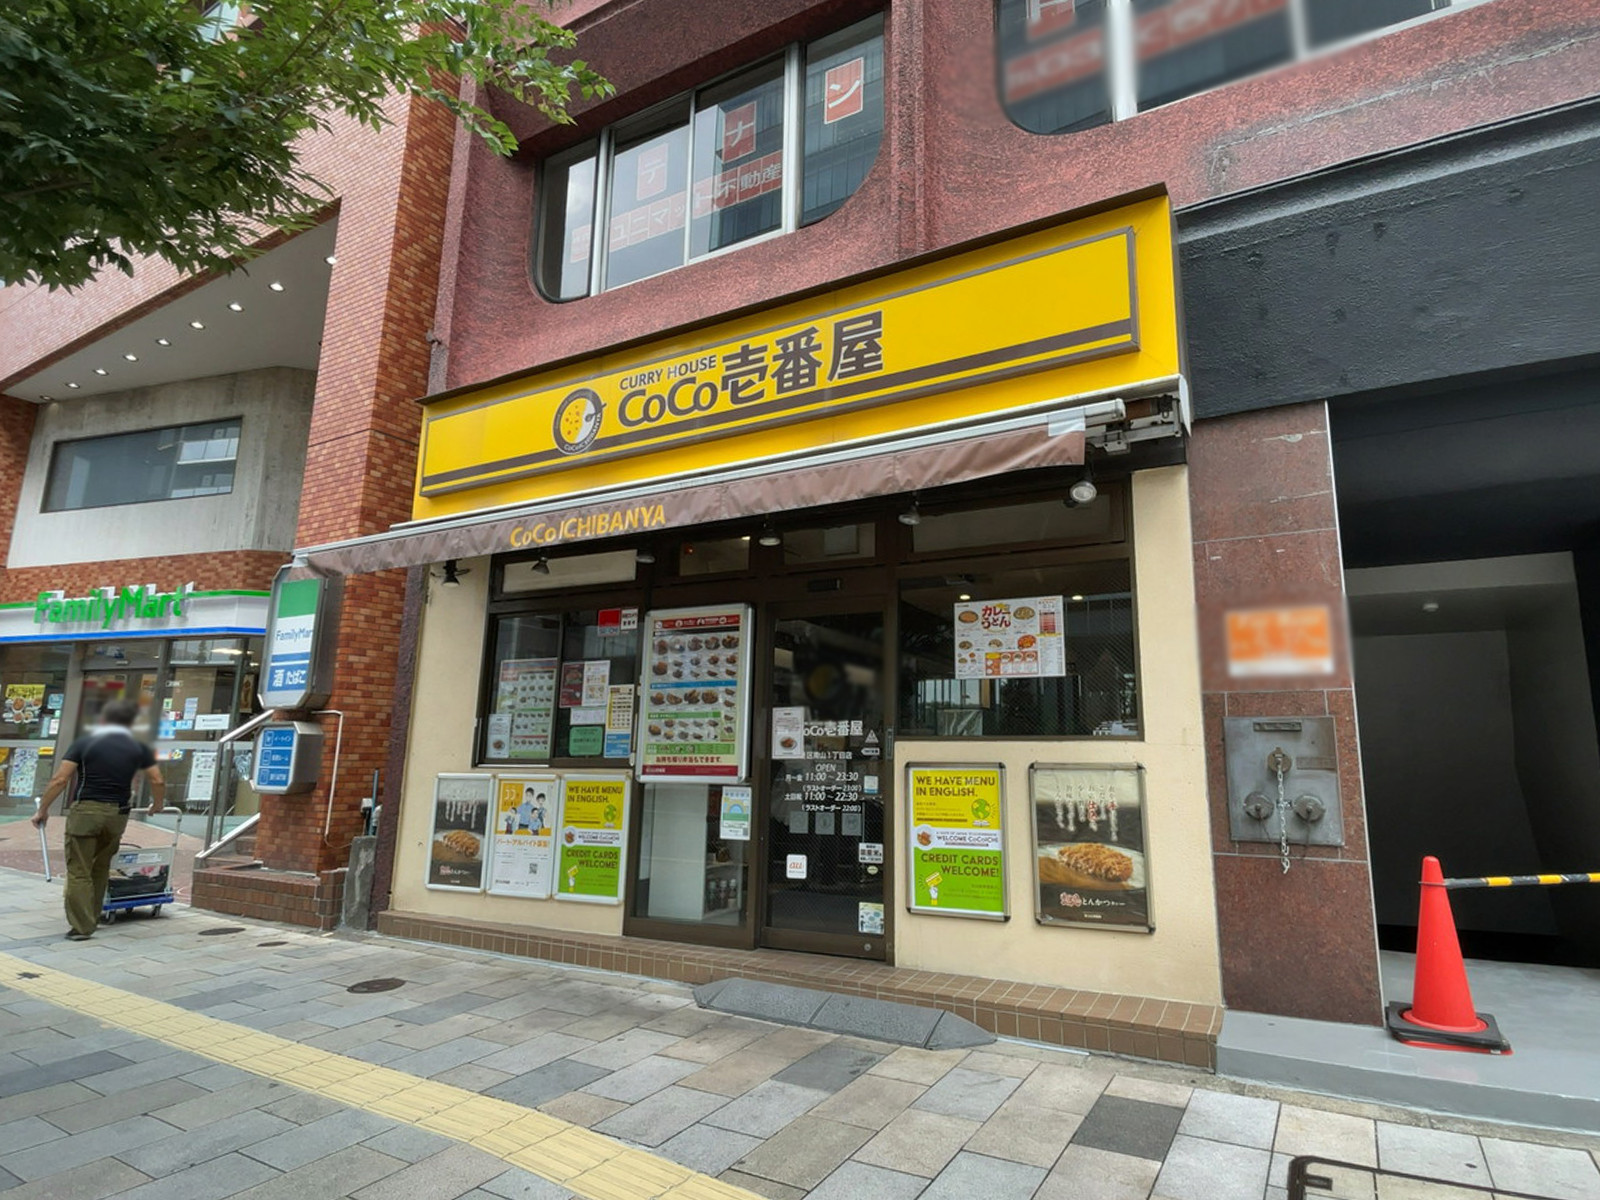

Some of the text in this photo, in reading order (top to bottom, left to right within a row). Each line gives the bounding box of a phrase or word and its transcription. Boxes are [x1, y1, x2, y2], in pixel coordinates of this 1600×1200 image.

[827, 79, 862, 110] ン
[617, 310, 884, 428] CoCo壱番屋
[618, 354, 718, 391] CURRY HOUSE
[33, 584, 187, 629] FamilyMart
[982, 604, 1011, 617] カレー
[981, 616, 1012, 629] うどん
[275, 627, 313, 644] FamilyMar
[802, 719, 864, 737] oCo壱番屋
[815, 763, 837, 772] OPEN
[916, 775, 995, 786] WE HAVE MENU
[567, 785, 623, 795] WE HAVE MENU
[915, 787, 978, 798] IN ENGLISH.
[567, 795, 575, 803] IN
[566, 849, 618, 860] CREDIT CARDS
[921, 852, 999, 866] CREDIT CARDS
[940, 865, 999, 878] WELCOME!
